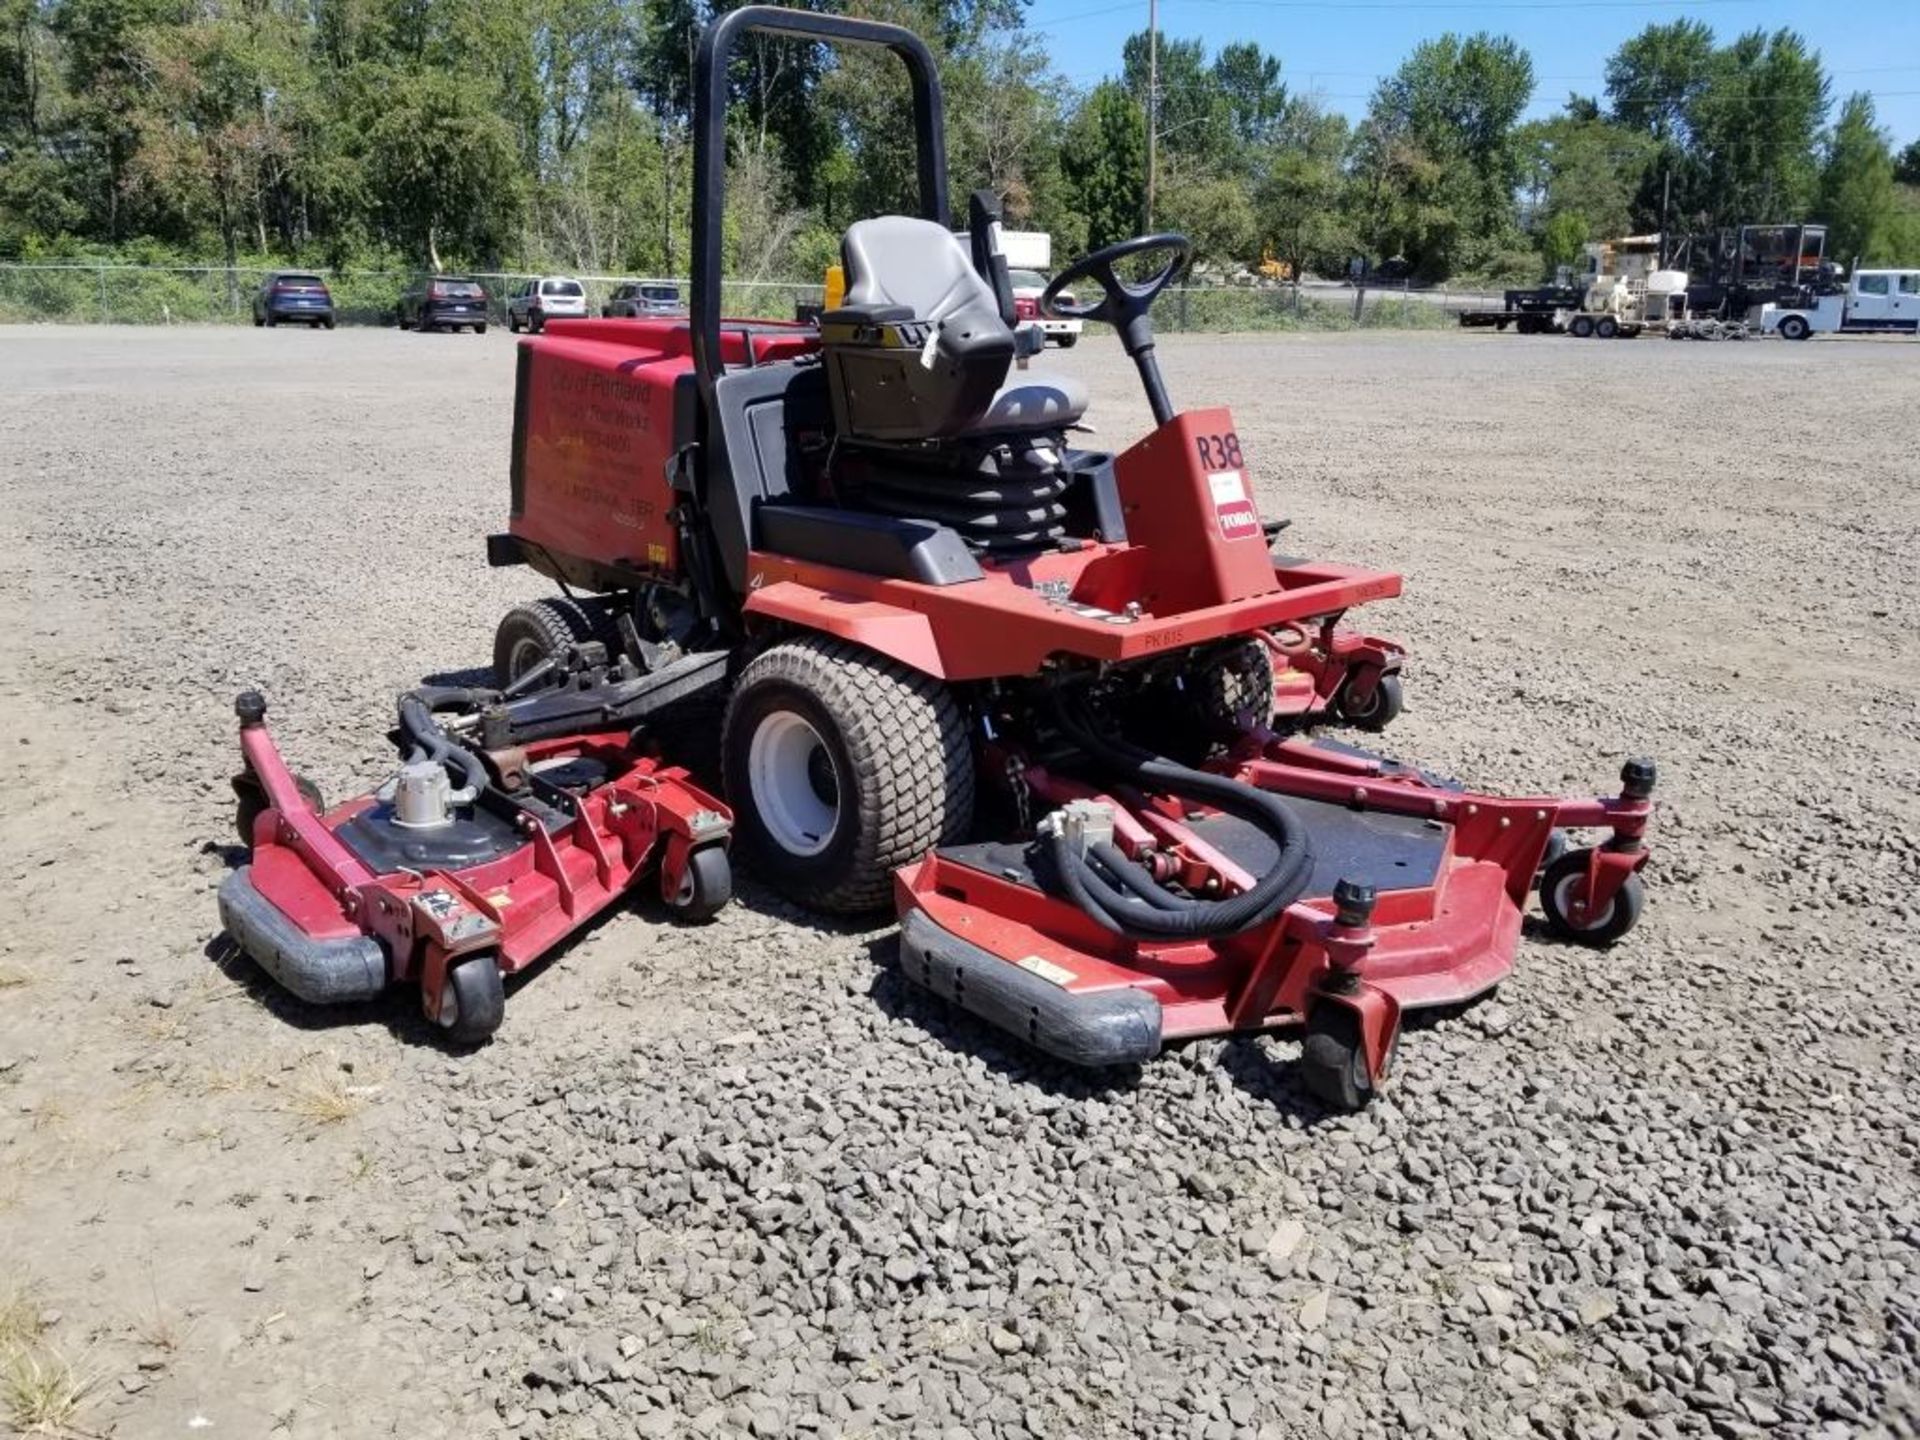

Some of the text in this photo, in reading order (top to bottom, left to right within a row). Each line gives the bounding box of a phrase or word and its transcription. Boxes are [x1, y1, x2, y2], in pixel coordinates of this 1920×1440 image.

[590, 372, 652, 403] Portland
[1196, 433, 1244, 470] R38
[1220, 511, 1256, 530] TORO
[1144, 632, 1161, 649] PK
